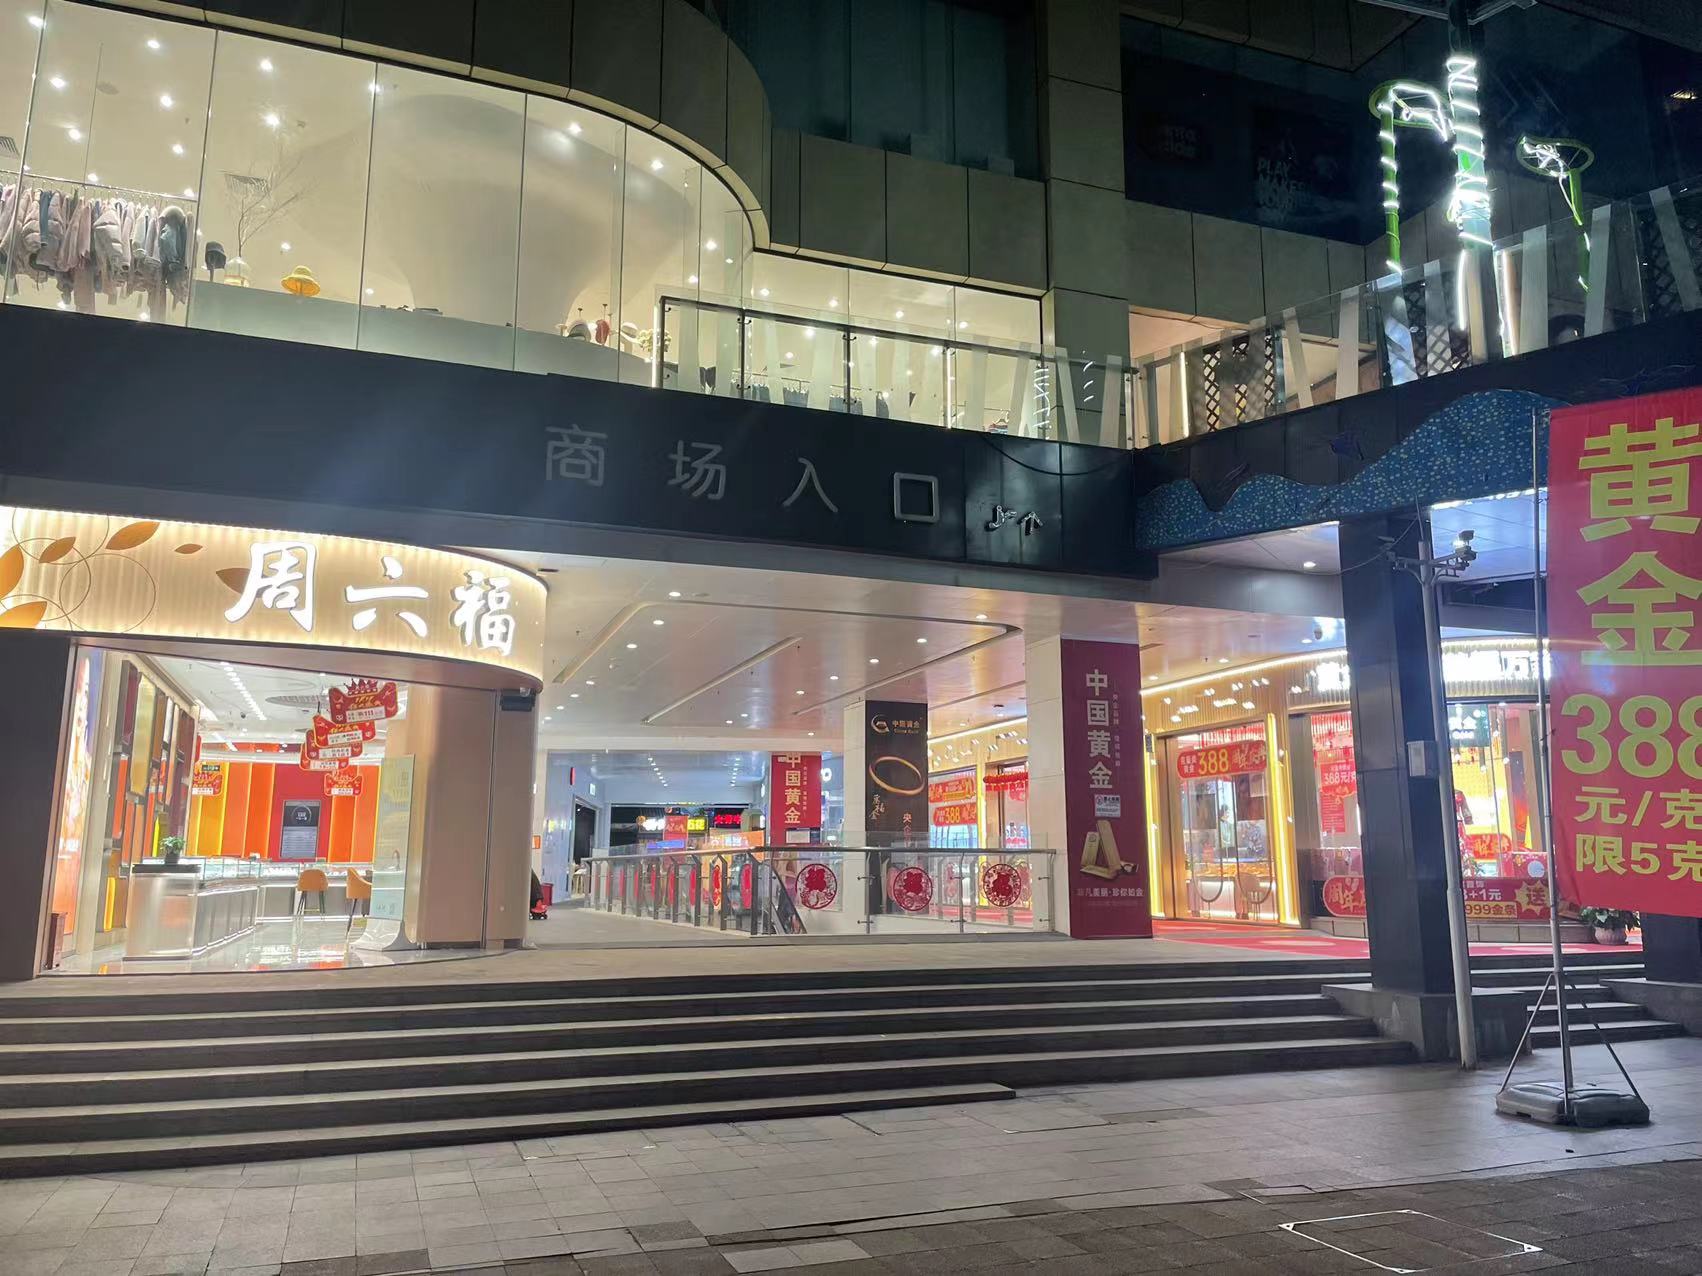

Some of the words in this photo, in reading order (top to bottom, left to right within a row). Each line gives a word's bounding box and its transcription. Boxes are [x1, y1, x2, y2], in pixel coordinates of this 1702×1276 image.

[545, 424, 940, 523] 商场入口
[1576, 417, 1702, 665] 黄金
[224, 542, 516, 656] 周六福
[1085, 668, 1113, 789] 中国黄金
[1199, 749, 1229, 774] 388
[1573, 786, 1702, 830] 元/克
[1574, 833, 1702, 882] 限5克
